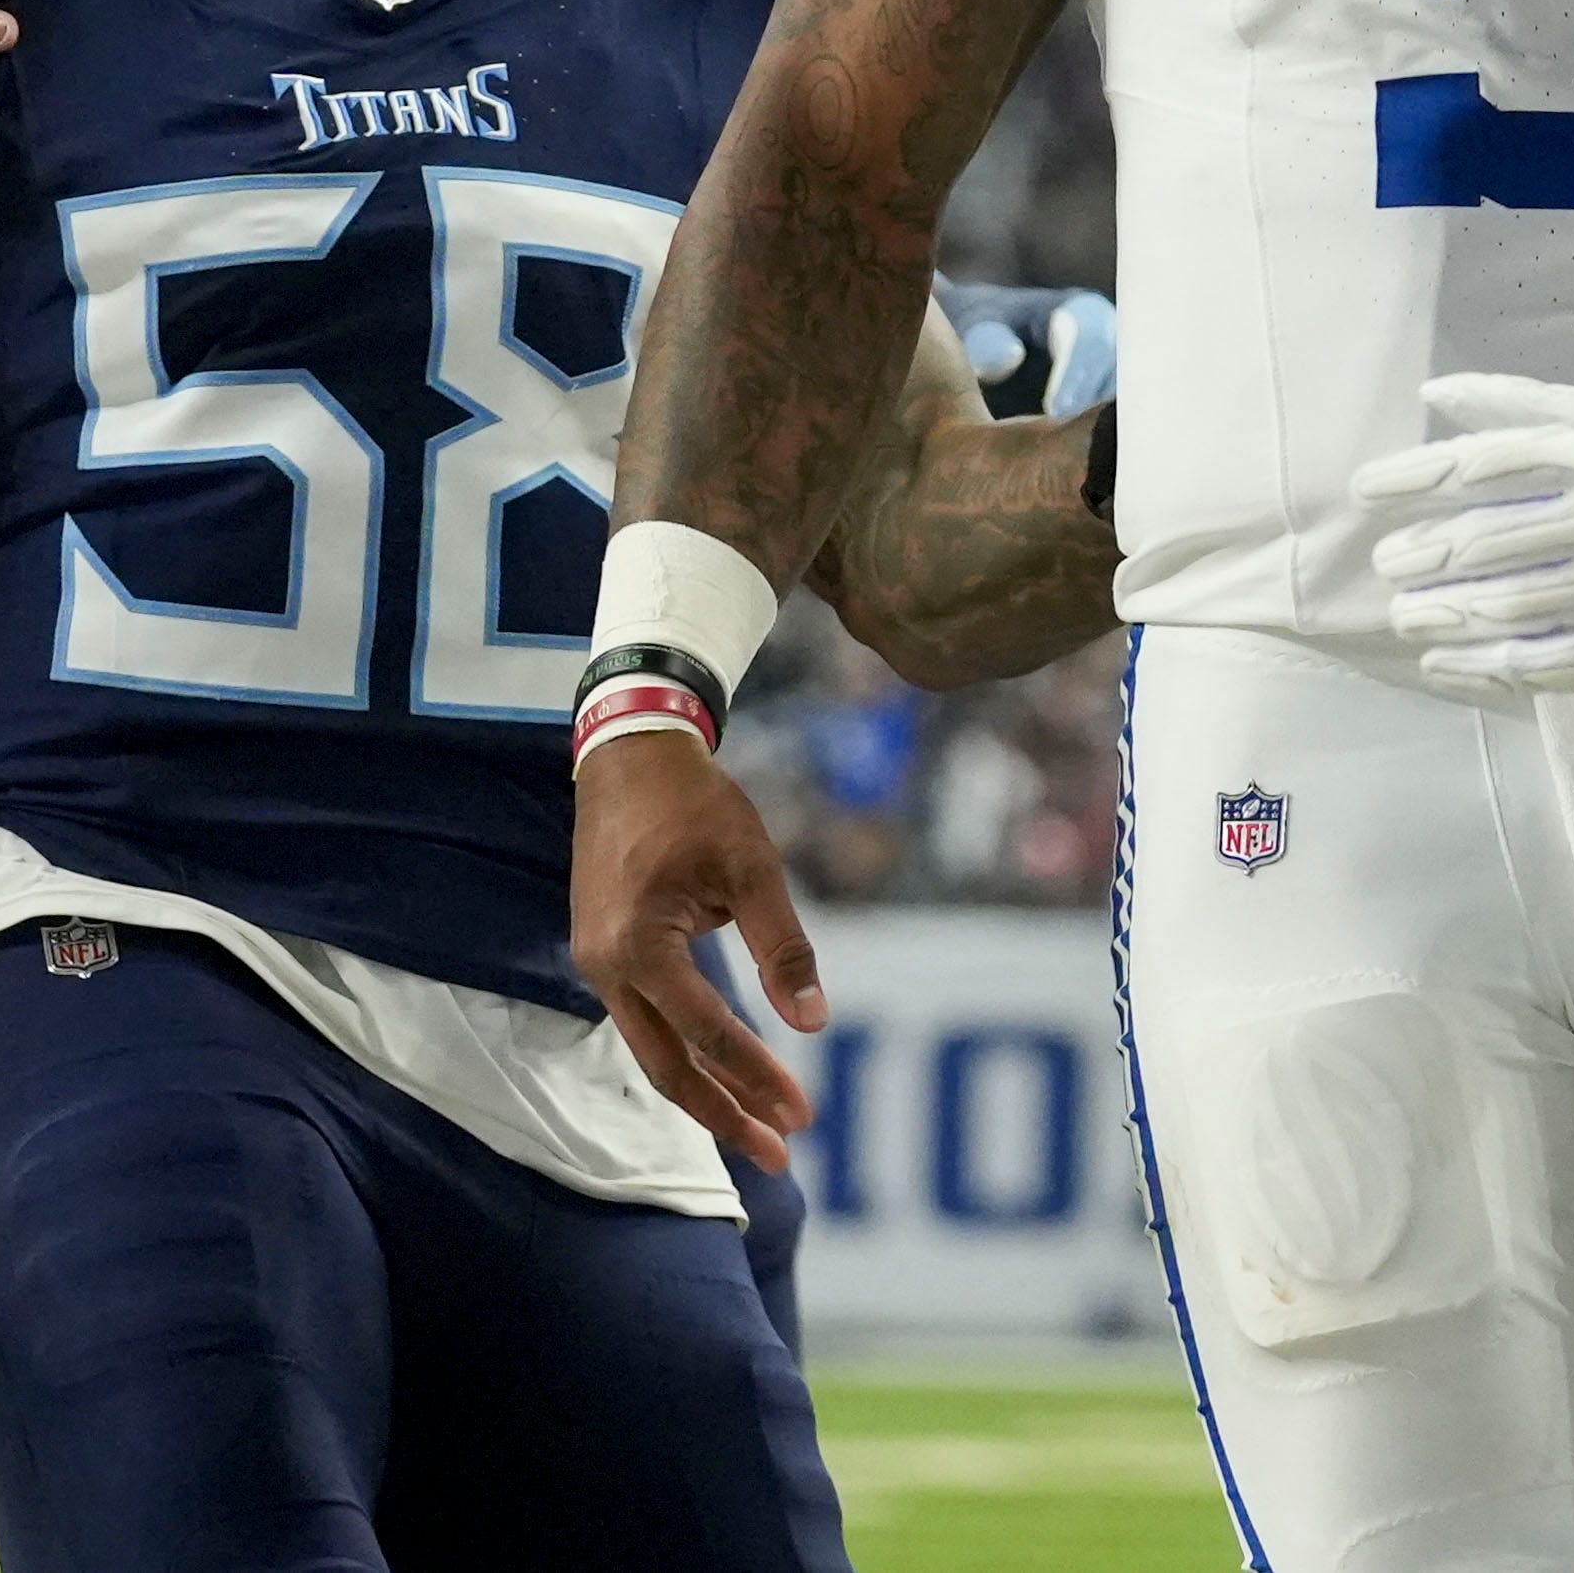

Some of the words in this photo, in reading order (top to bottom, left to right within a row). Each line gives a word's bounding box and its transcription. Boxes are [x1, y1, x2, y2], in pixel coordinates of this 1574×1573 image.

[271, 62, 517, 151] TITANS
[50, 164, 684, 724] 58
[1225, 822, 1275, 858] NFL
[58, 941, 107, 965] NFL
